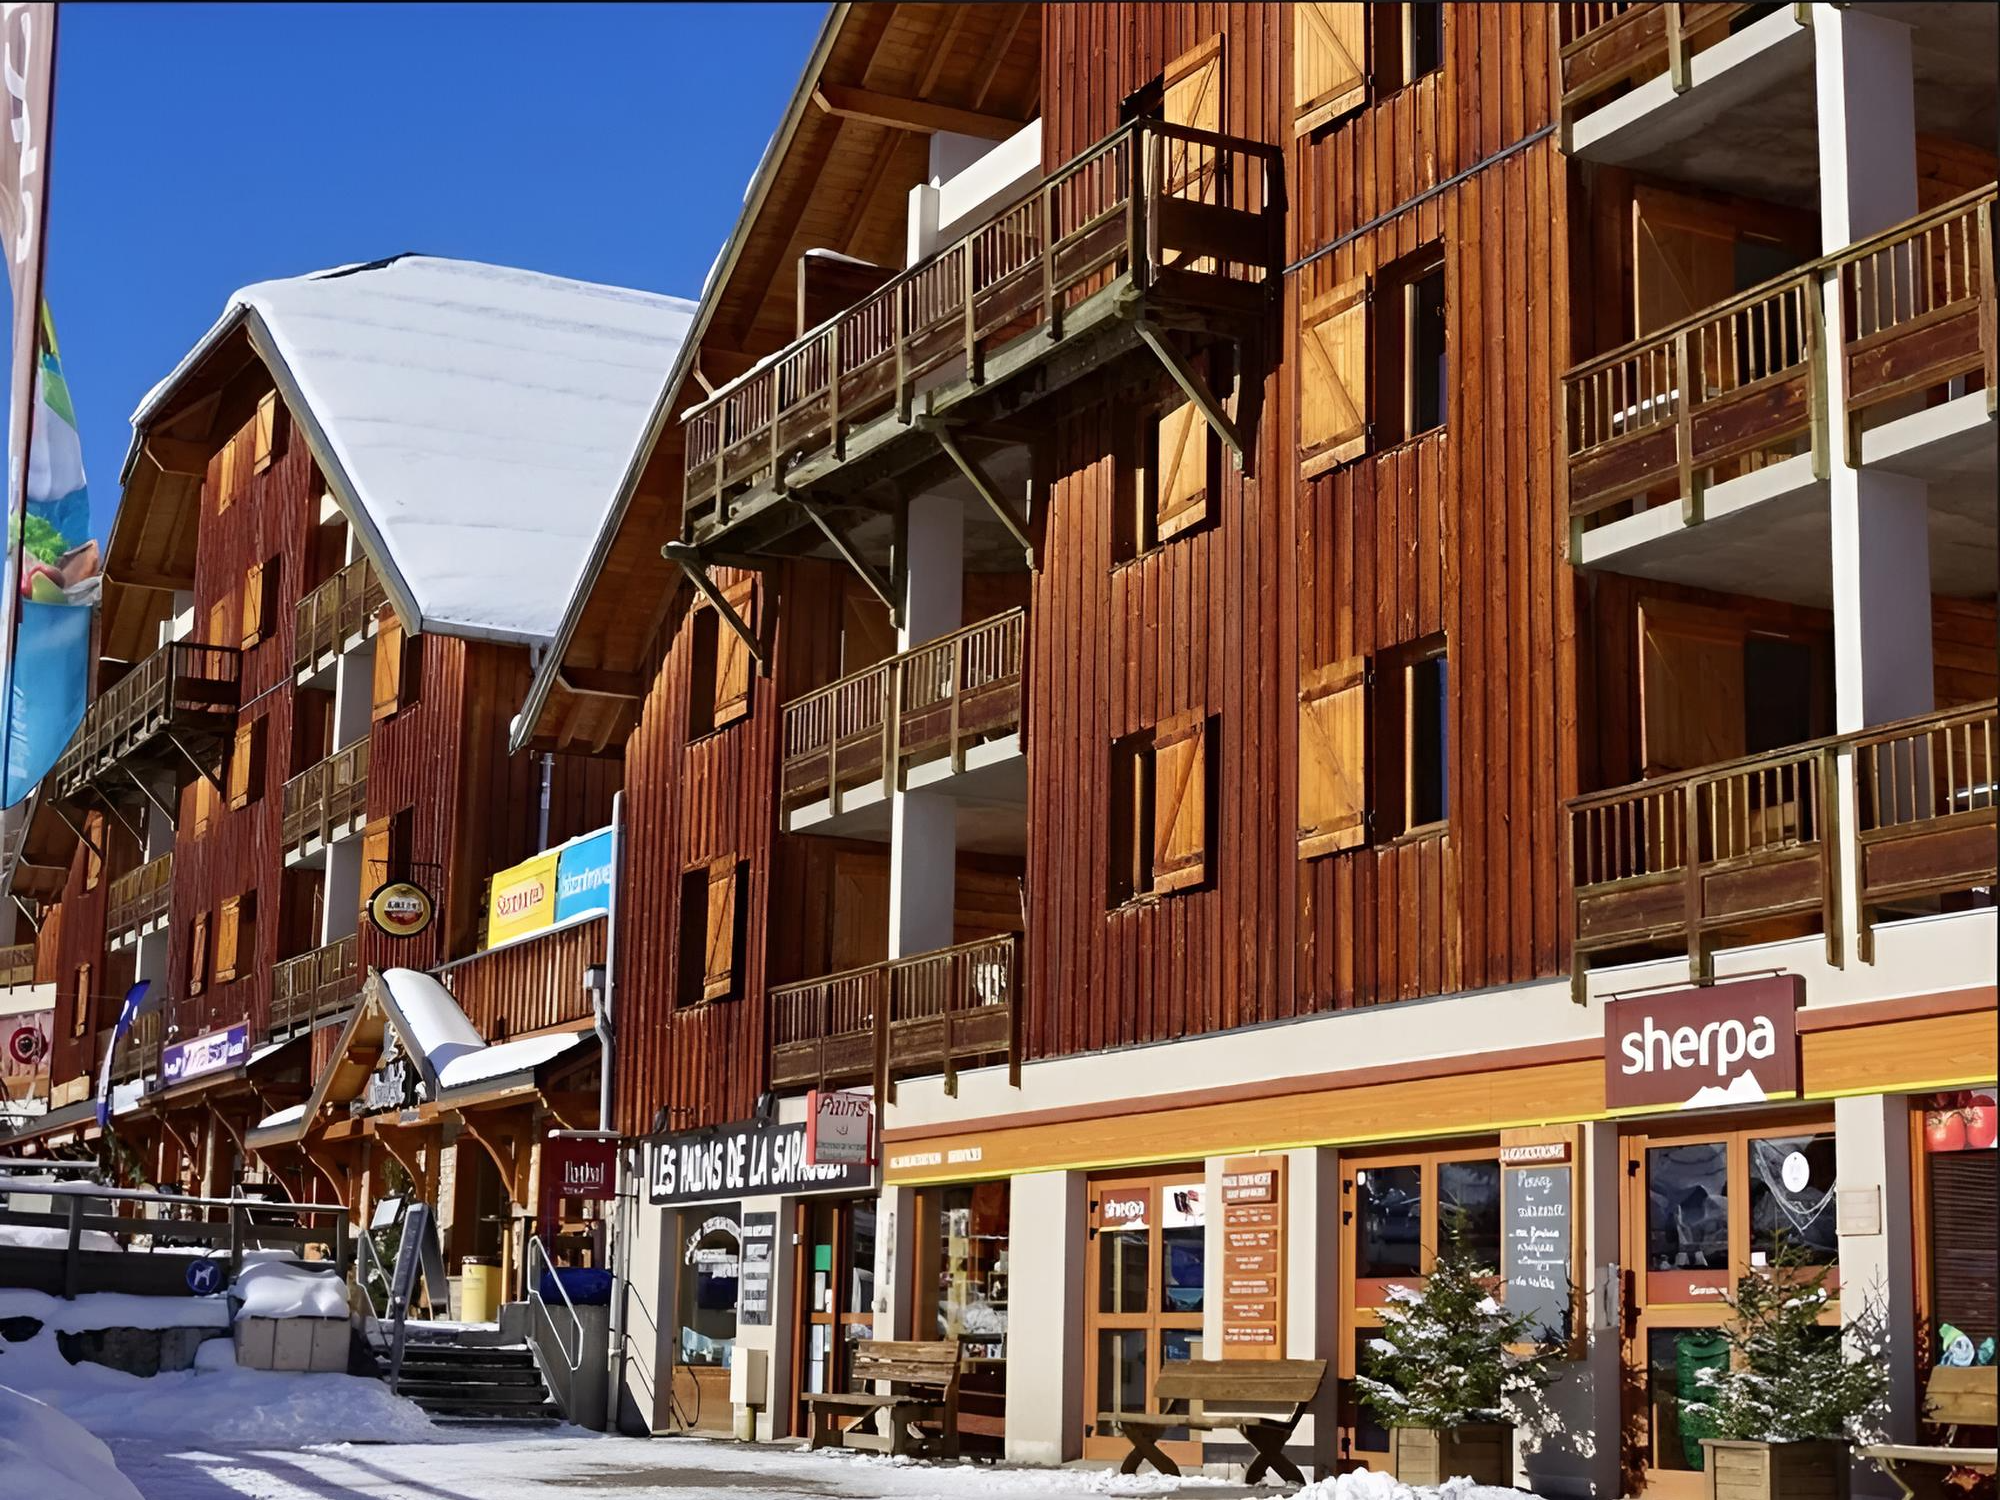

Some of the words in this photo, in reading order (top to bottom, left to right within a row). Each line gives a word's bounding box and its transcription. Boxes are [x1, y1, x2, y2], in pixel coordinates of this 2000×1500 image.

[1621, 1015, 1776, 1076] sherpa
[651, 1144, 677, 1197] LES
[680, 1140, 724, 1194] PAINS
[725, 1133, 747, 1189] DE
[749, 1134, 768, 1187] LA
